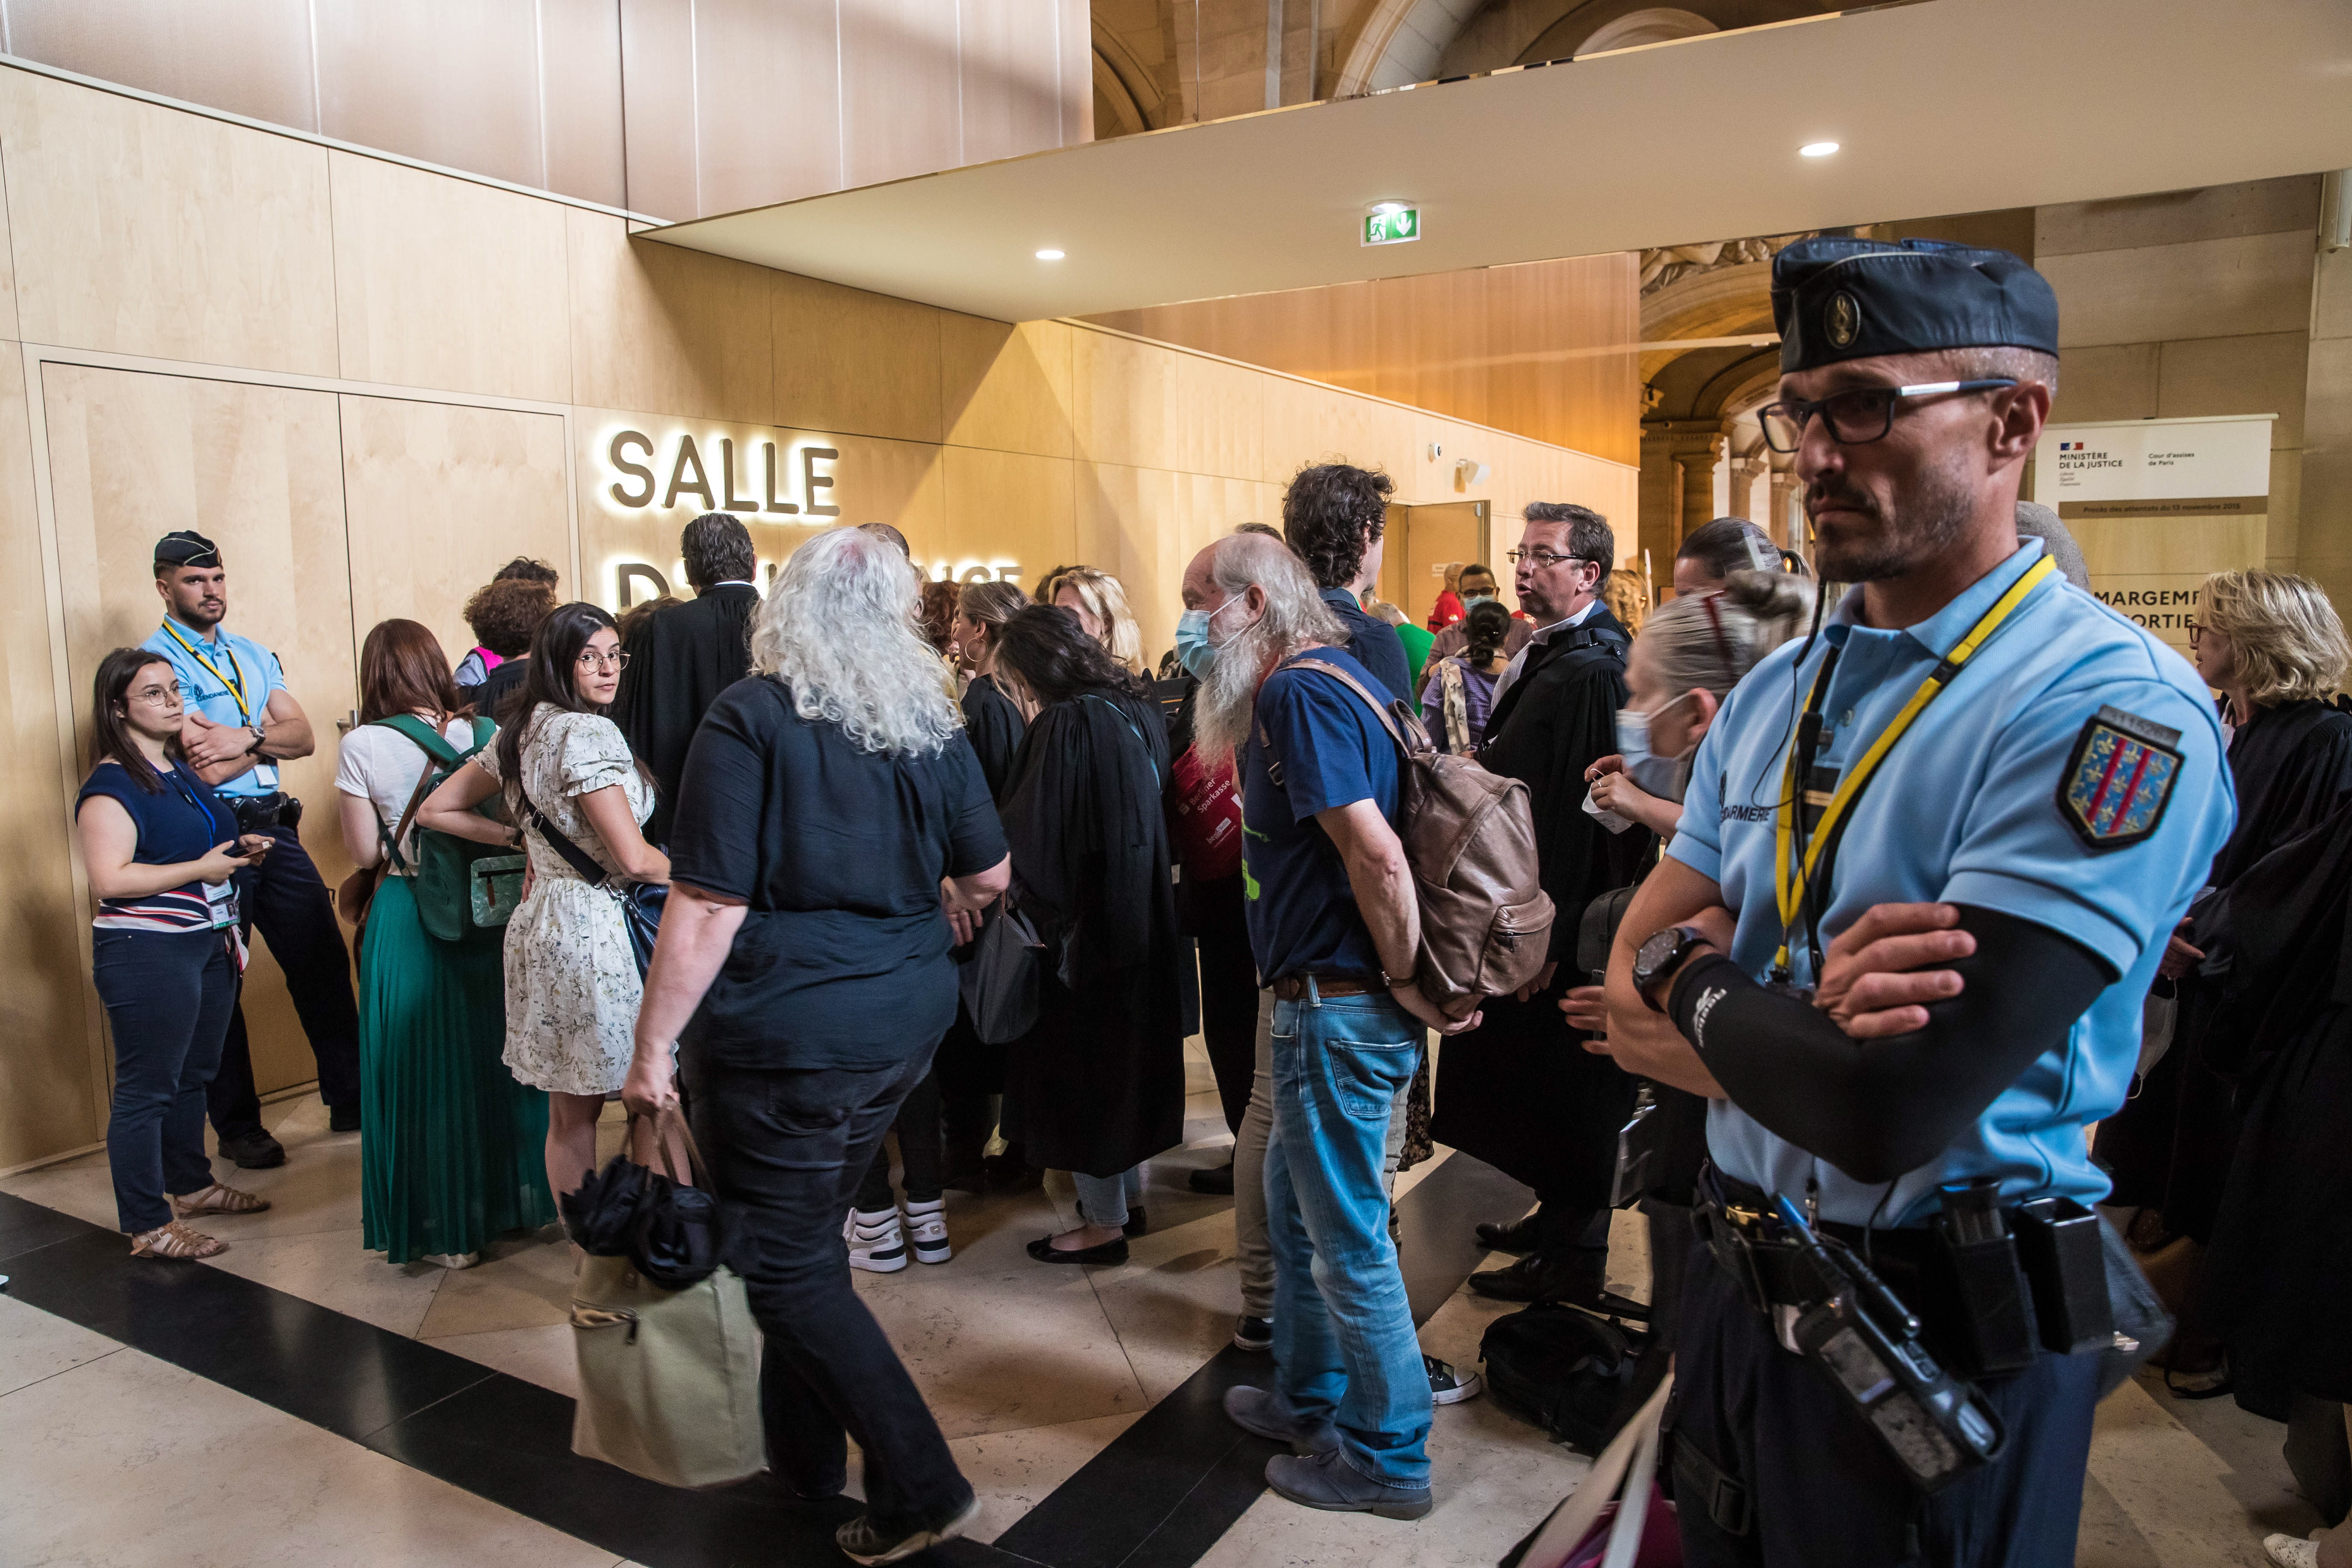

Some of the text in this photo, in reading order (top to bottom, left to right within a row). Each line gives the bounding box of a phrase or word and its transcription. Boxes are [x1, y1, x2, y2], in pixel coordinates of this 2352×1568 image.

[2059, 452, 2108, 461] MINISTÈRE
[2087, 460, 2123, 469] JUSTICE
[608, 430, 840, 516] SALLE
[2123, 614, 2194, 629] ORTIE
[1190, 778, 1215, 805] Berliner
[1197, 780, 1231, 814] Sparkasse
